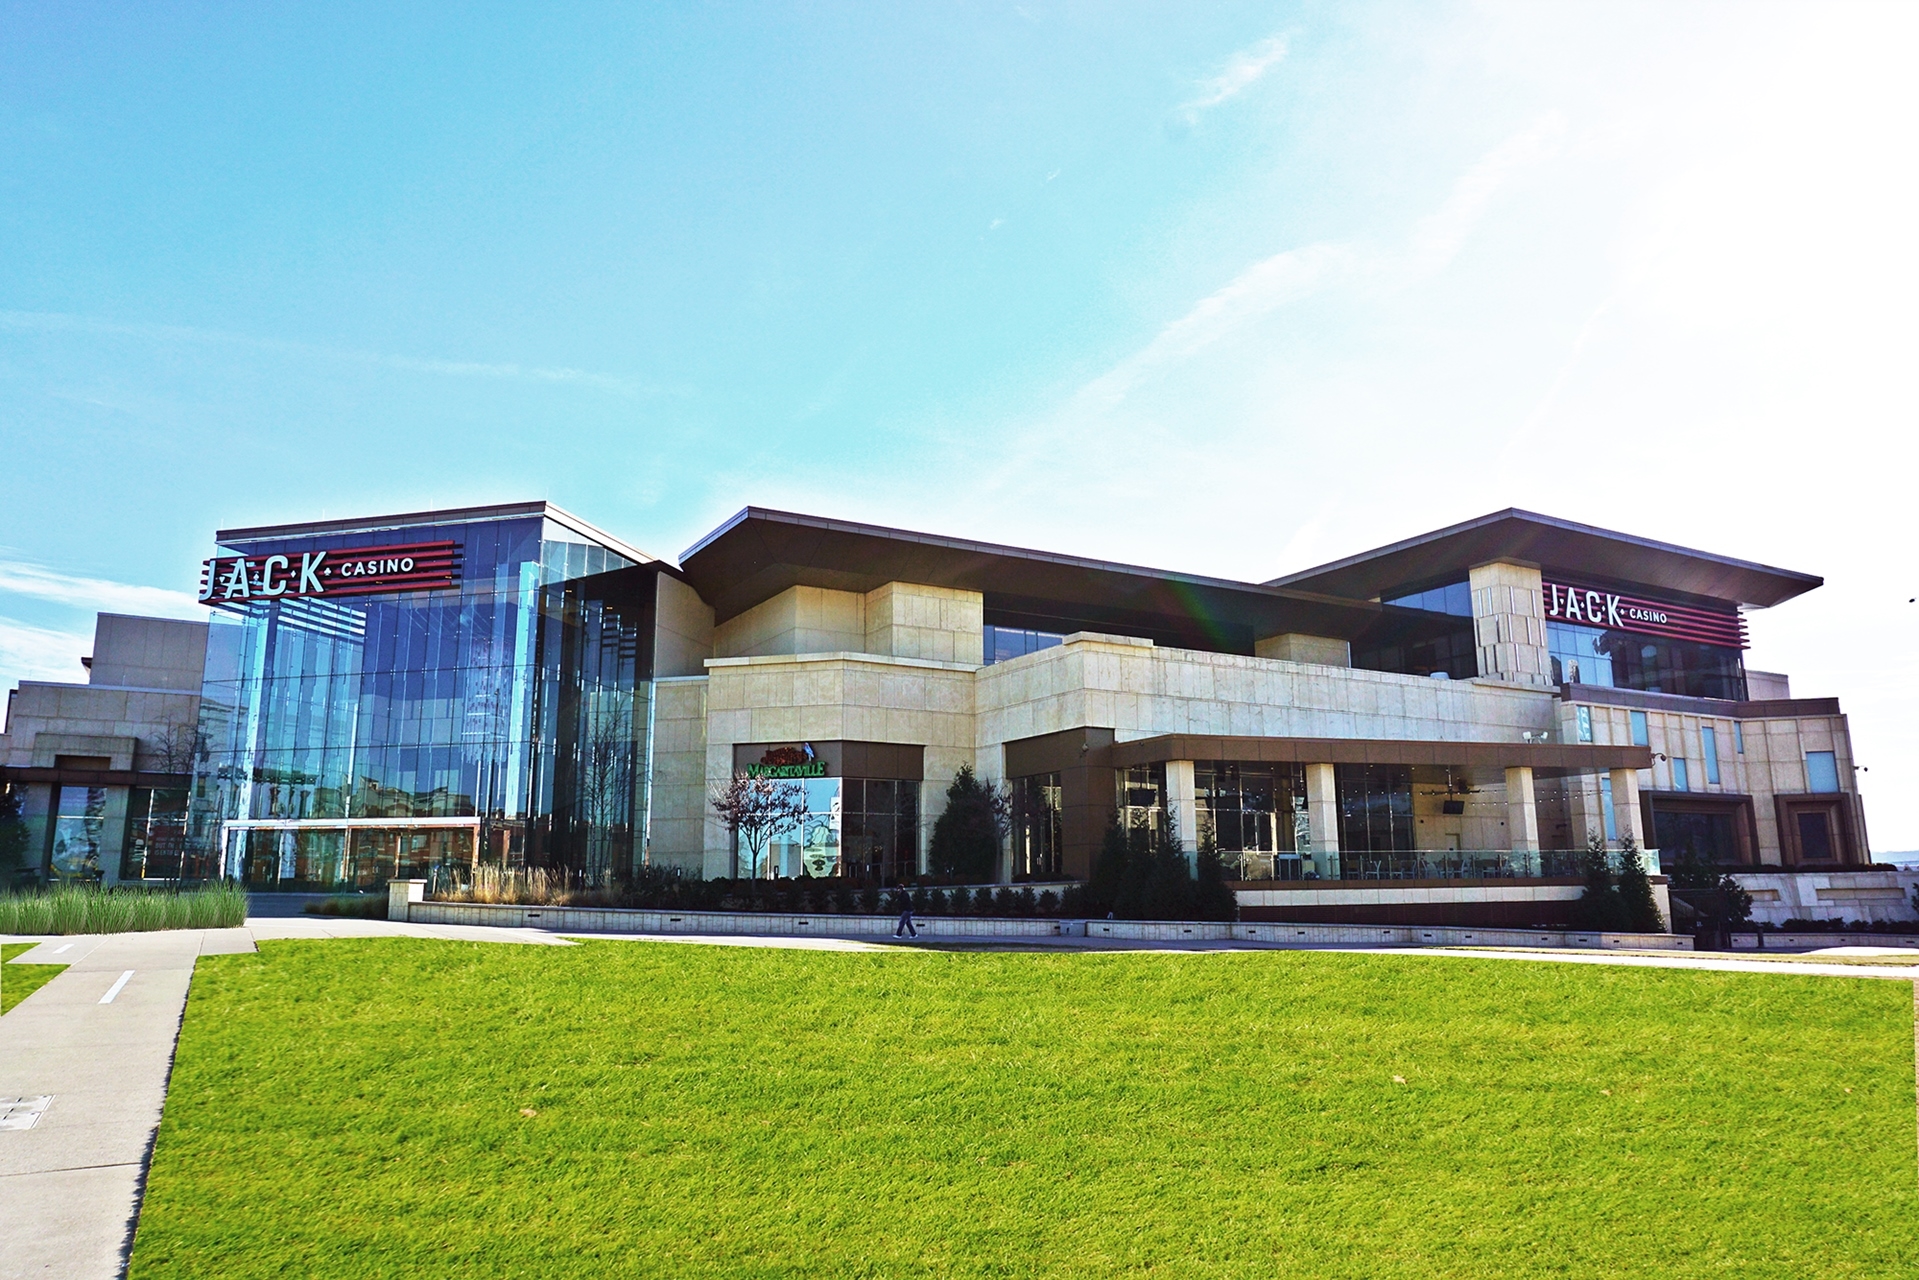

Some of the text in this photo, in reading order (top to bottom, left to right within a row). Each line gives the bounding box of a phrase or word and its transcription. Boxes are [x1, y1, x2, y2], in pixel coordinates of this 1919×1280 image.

[199, 551, 414, 600] JACK CASINO
[1550, 584, 1667, 627] JACK CASINO
